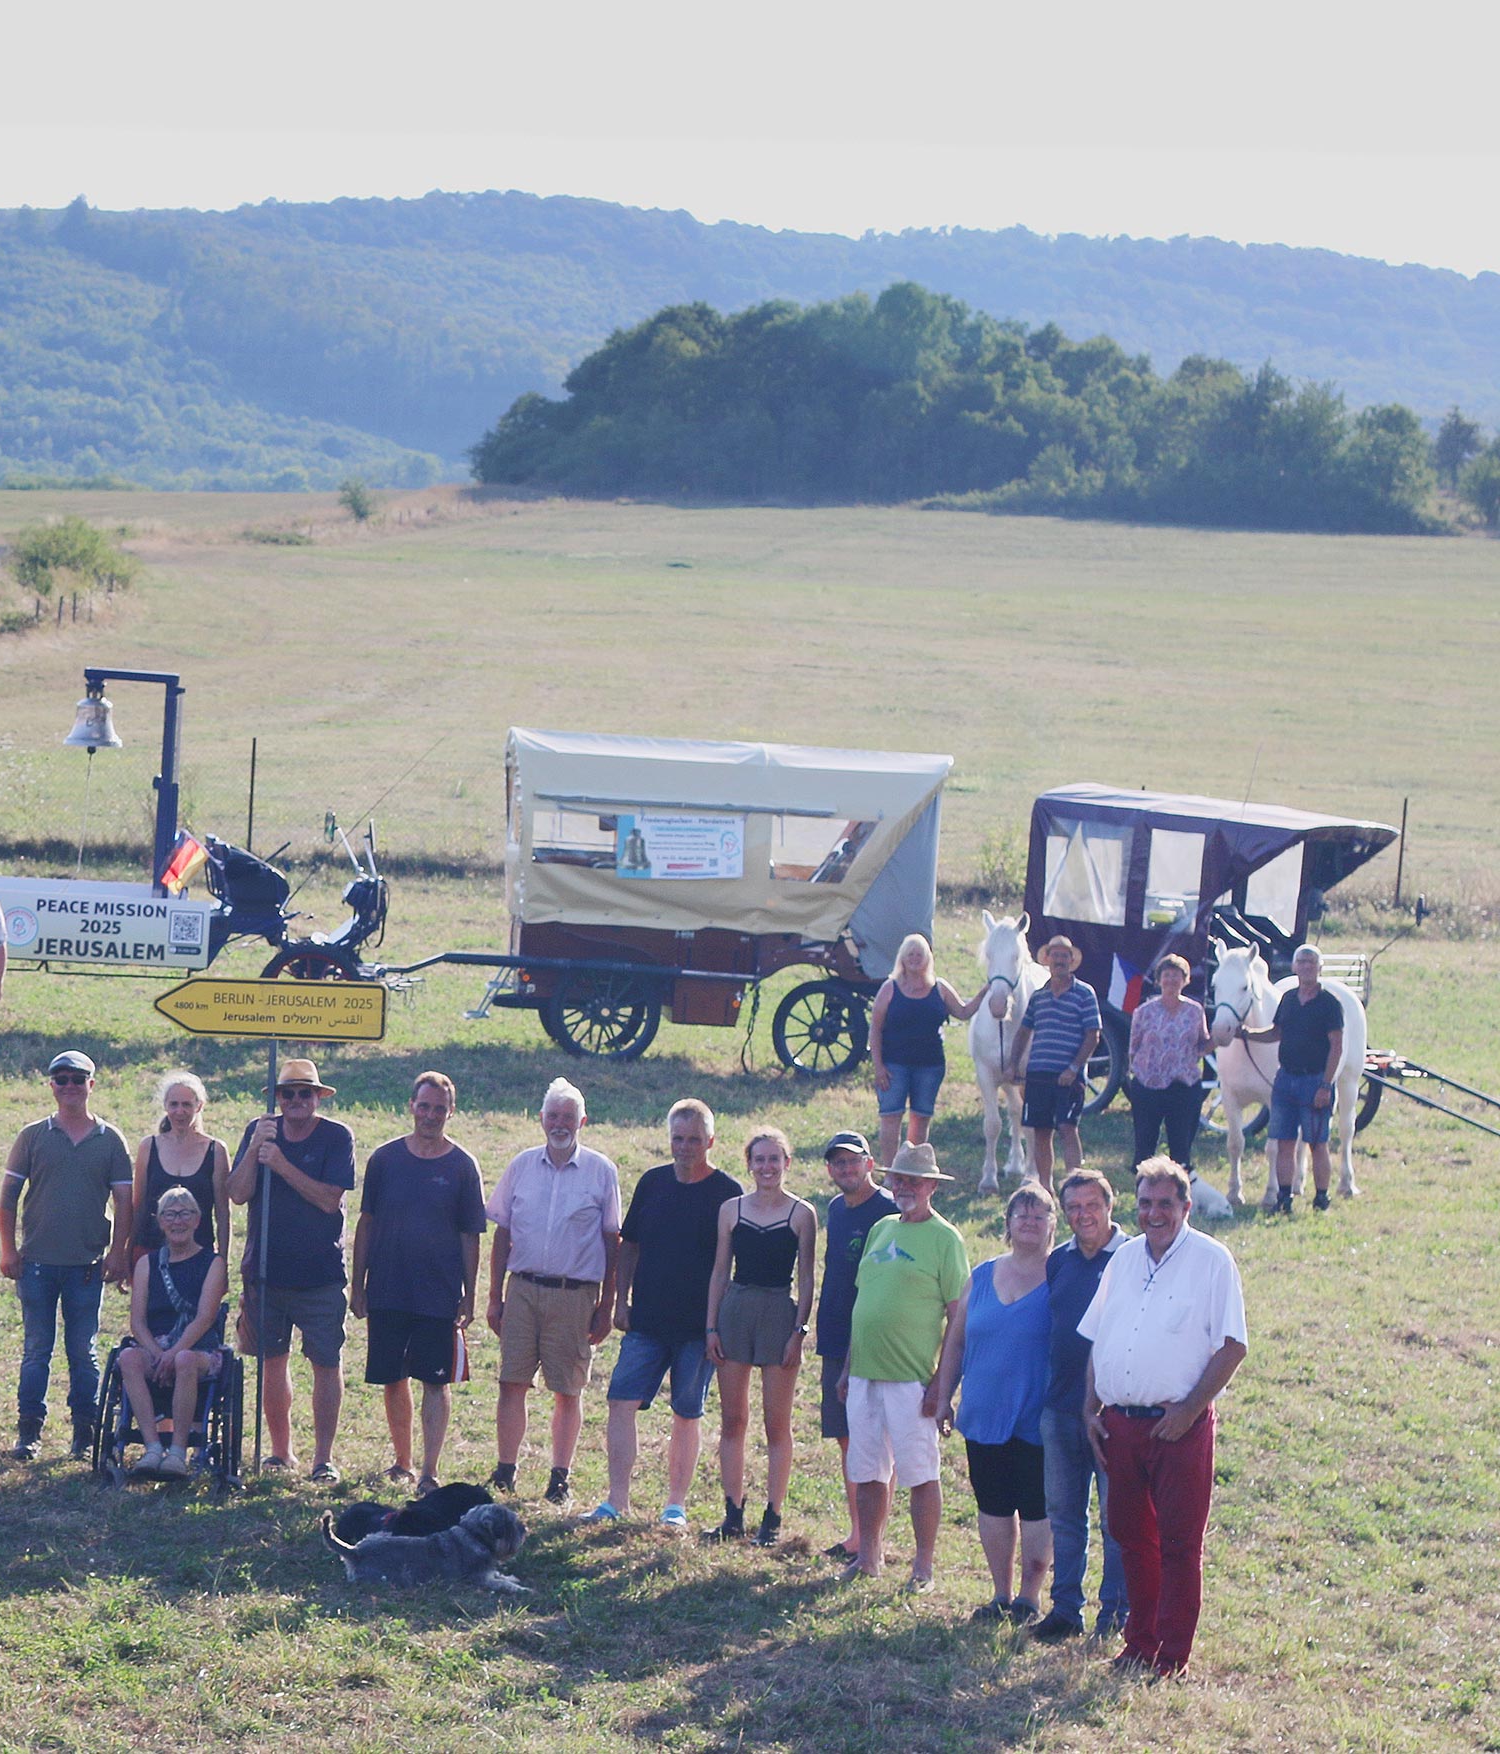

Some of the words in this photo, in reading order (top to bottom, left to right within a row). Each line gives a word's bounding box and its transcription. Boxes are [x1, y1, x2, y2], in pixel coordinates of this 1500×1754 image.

[36, 899, 89, 914] PEACE
[94, 902, 167, 918] MISSION
[80, 919, 122, 935] 2025
[34, 938, 165, 961] JERUSALEM
[174, 1001, 195, 1010] 4800
[195, 1002, 209, 1010] km
[213, 992, 255, 1005] BERLIN
[266, 994, 337, 1008] JERUSALEM
[344, 997, 374, 1010] 2025
[222, 1012, 276, 1023] Jerusalem
[282, 1012, 322, 1025] ירושלים
